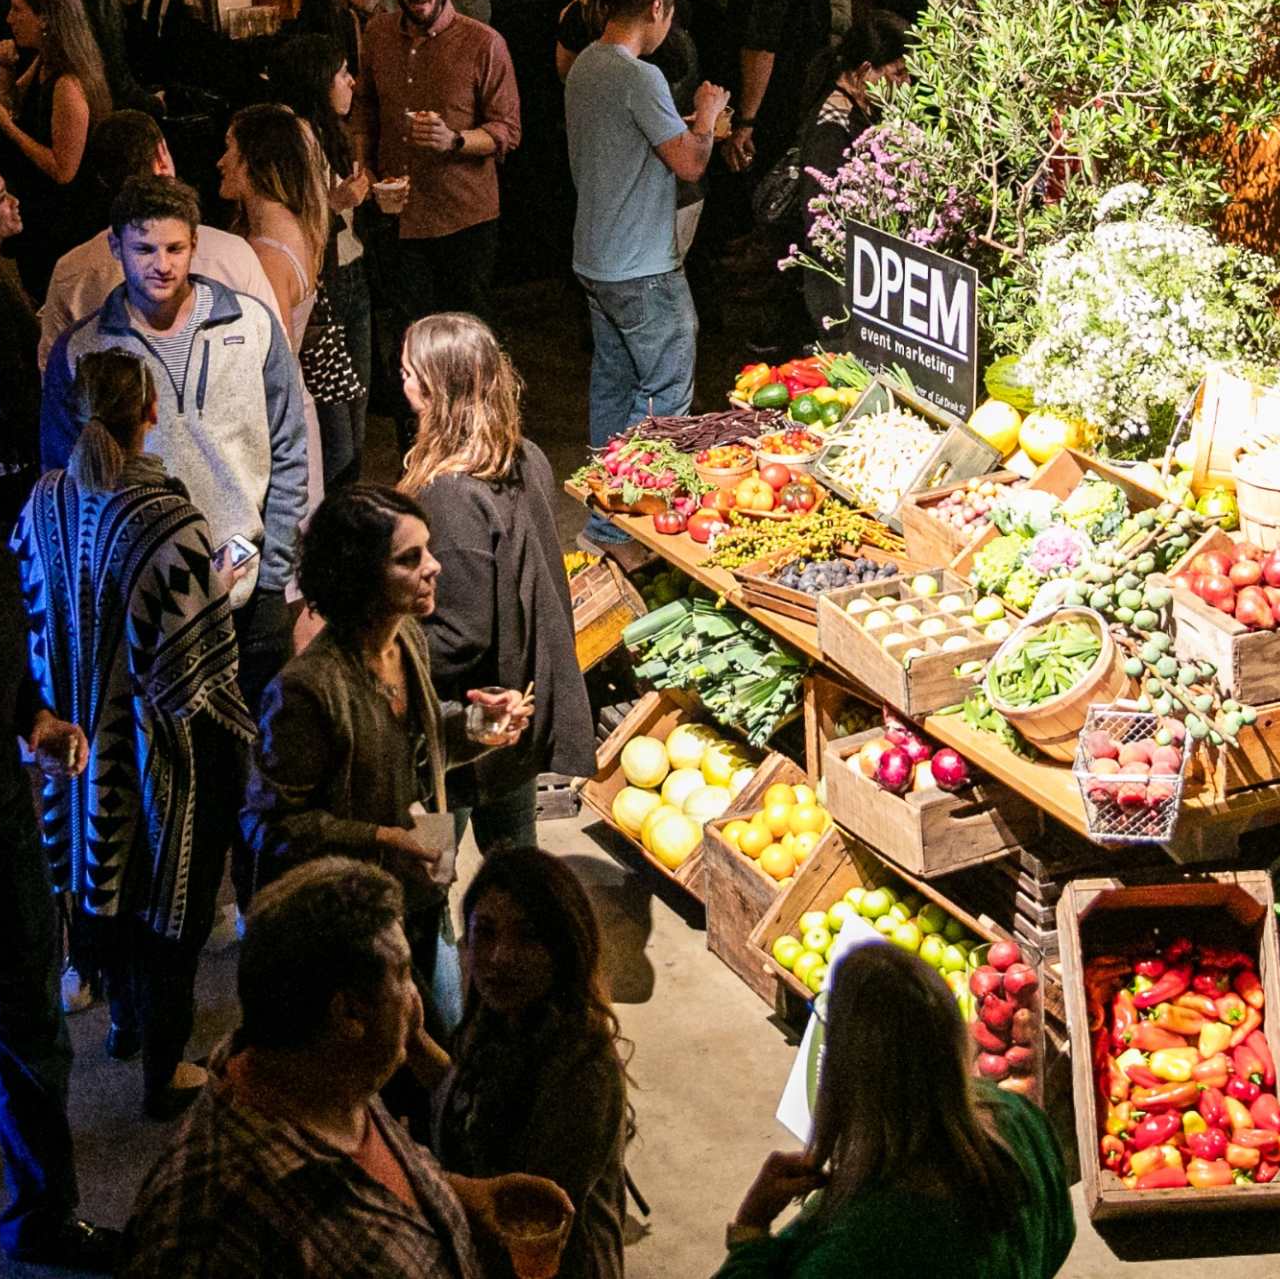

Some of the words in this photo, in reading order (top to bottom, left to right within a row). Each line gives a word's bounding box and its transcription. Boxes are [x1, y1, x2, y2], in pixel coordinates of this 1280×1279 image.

[852, 235, 968, 353] DPEM
[860, 325, 892, 350] event
[895, 339, 954, 384] marketing
